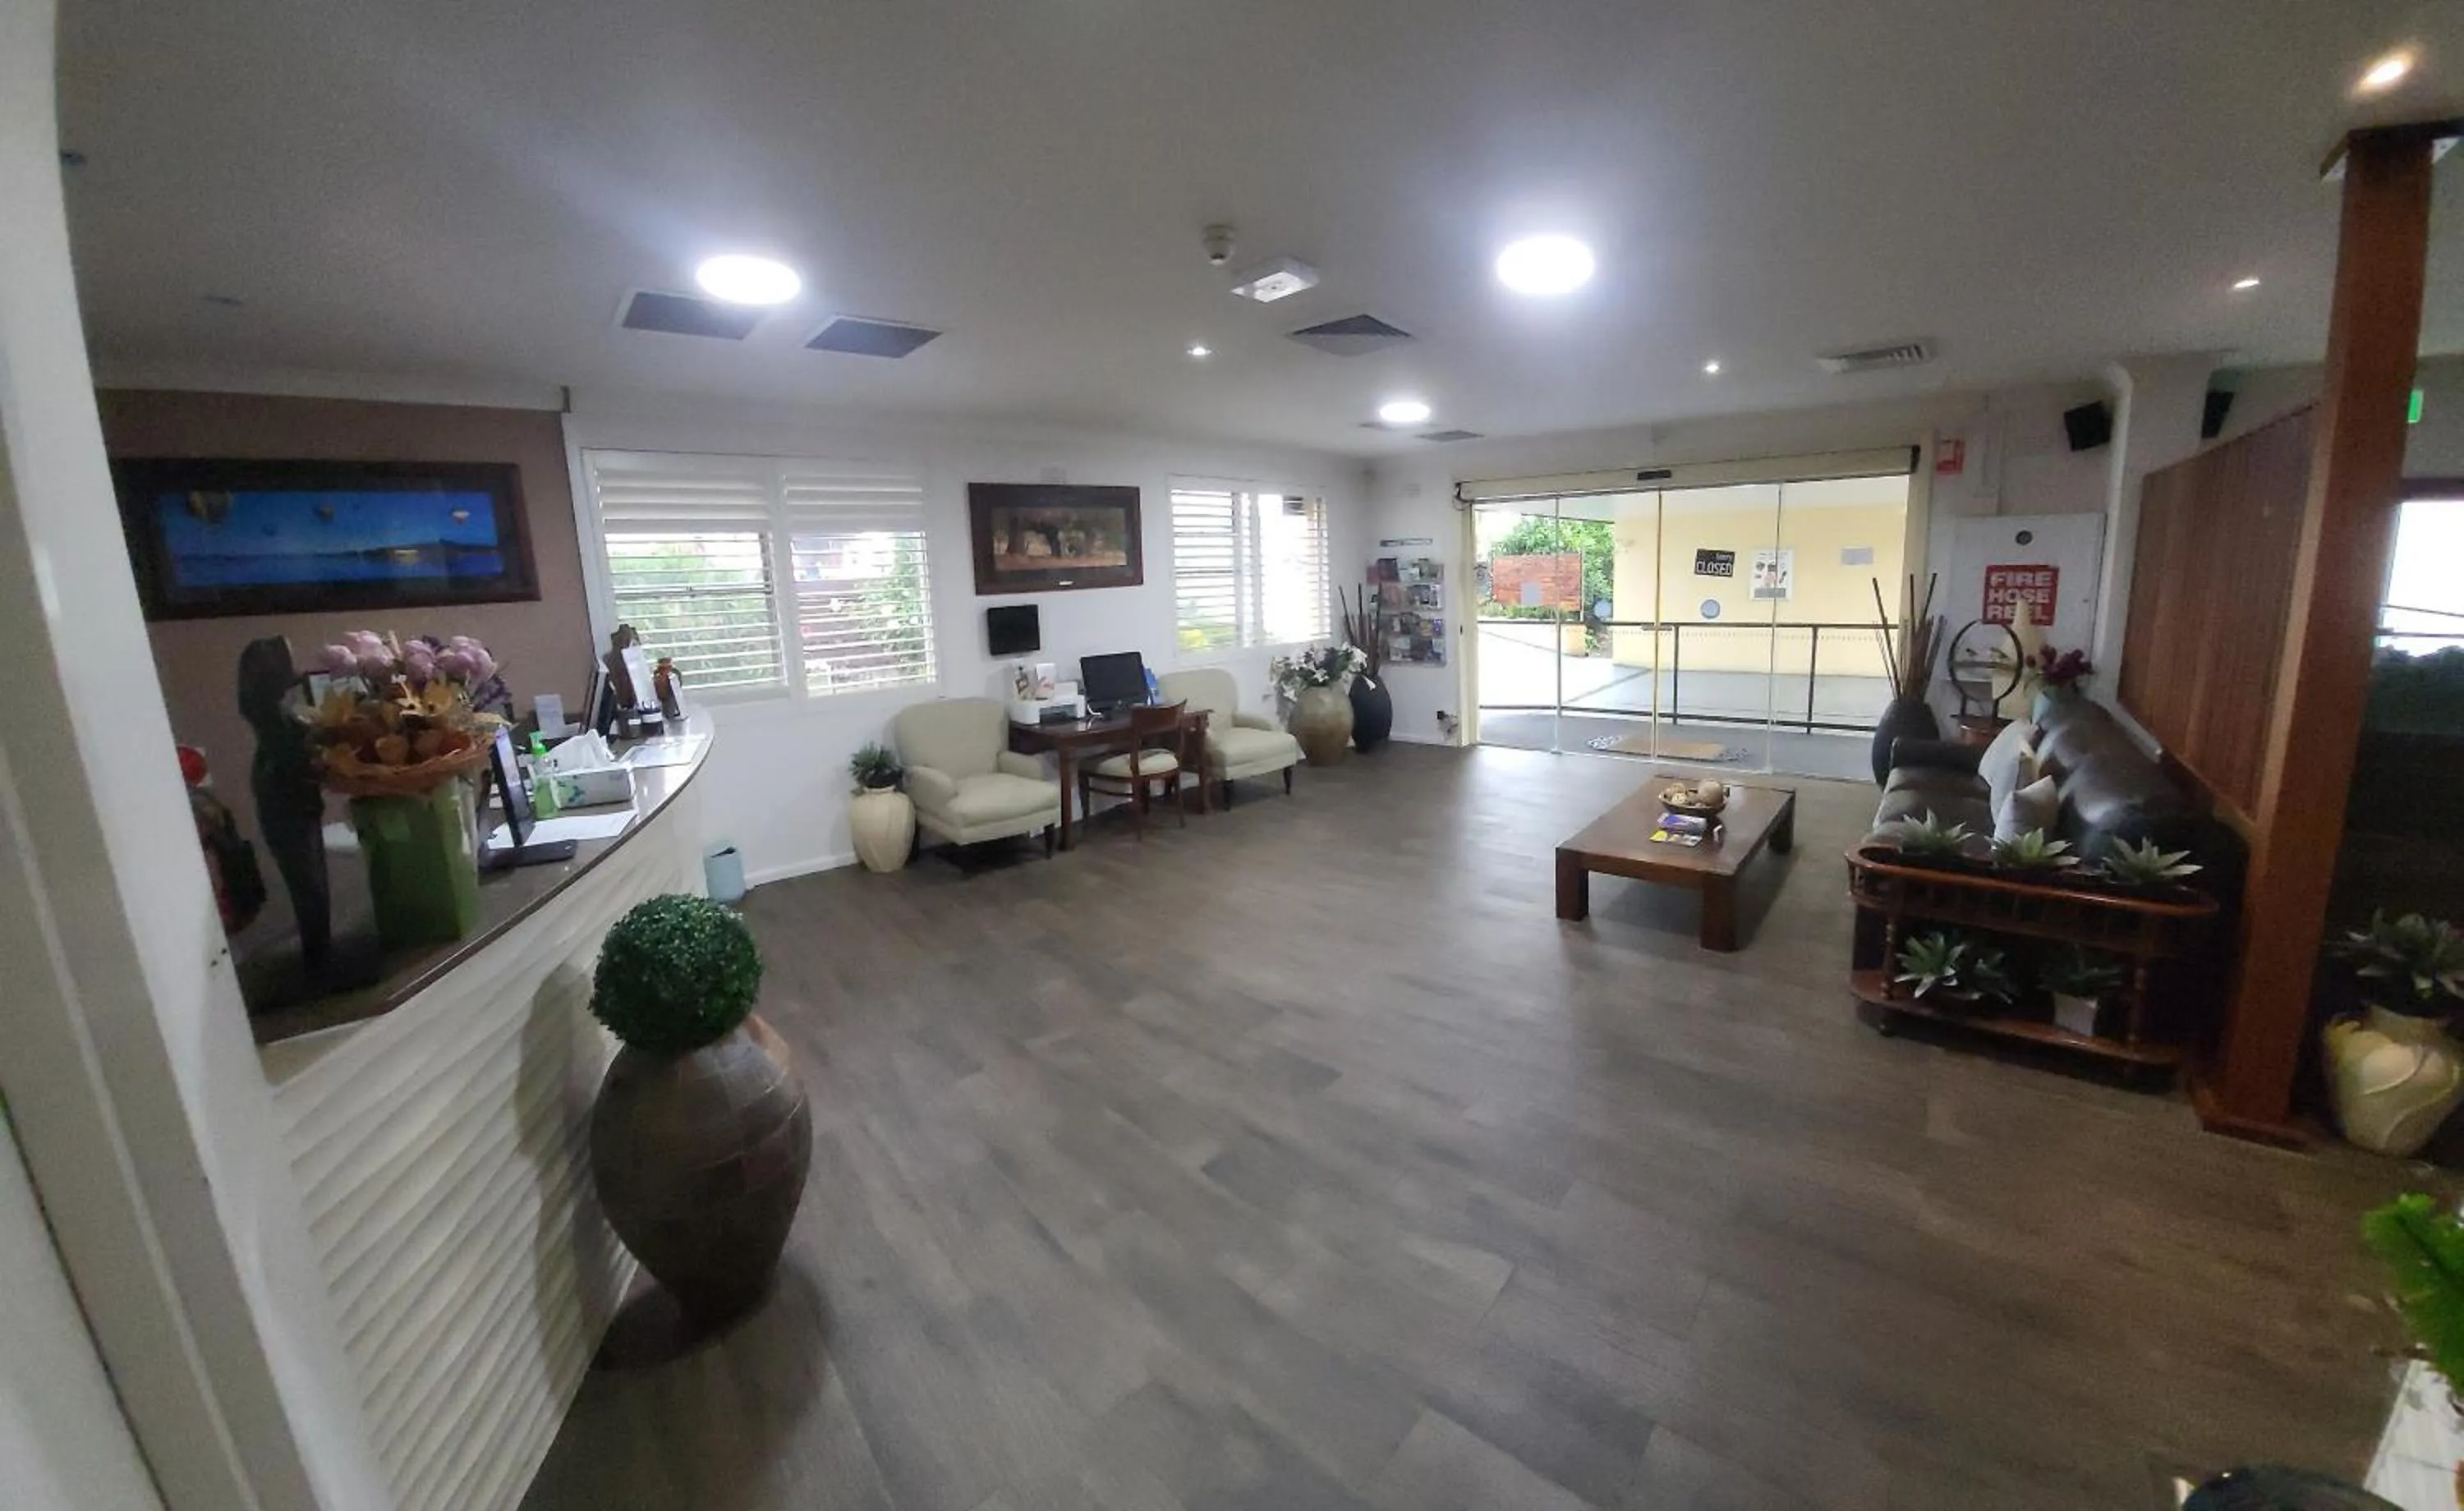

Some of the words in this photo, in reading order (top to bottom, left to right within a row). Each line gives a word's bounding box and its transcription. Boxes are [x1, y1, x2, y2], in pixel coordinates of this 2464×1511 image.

[1696, 560, 1732, 575] CLOSED
[1991, 571, 2051, 587] FIRE
[1988, 588, 2051, 604] HOSE
